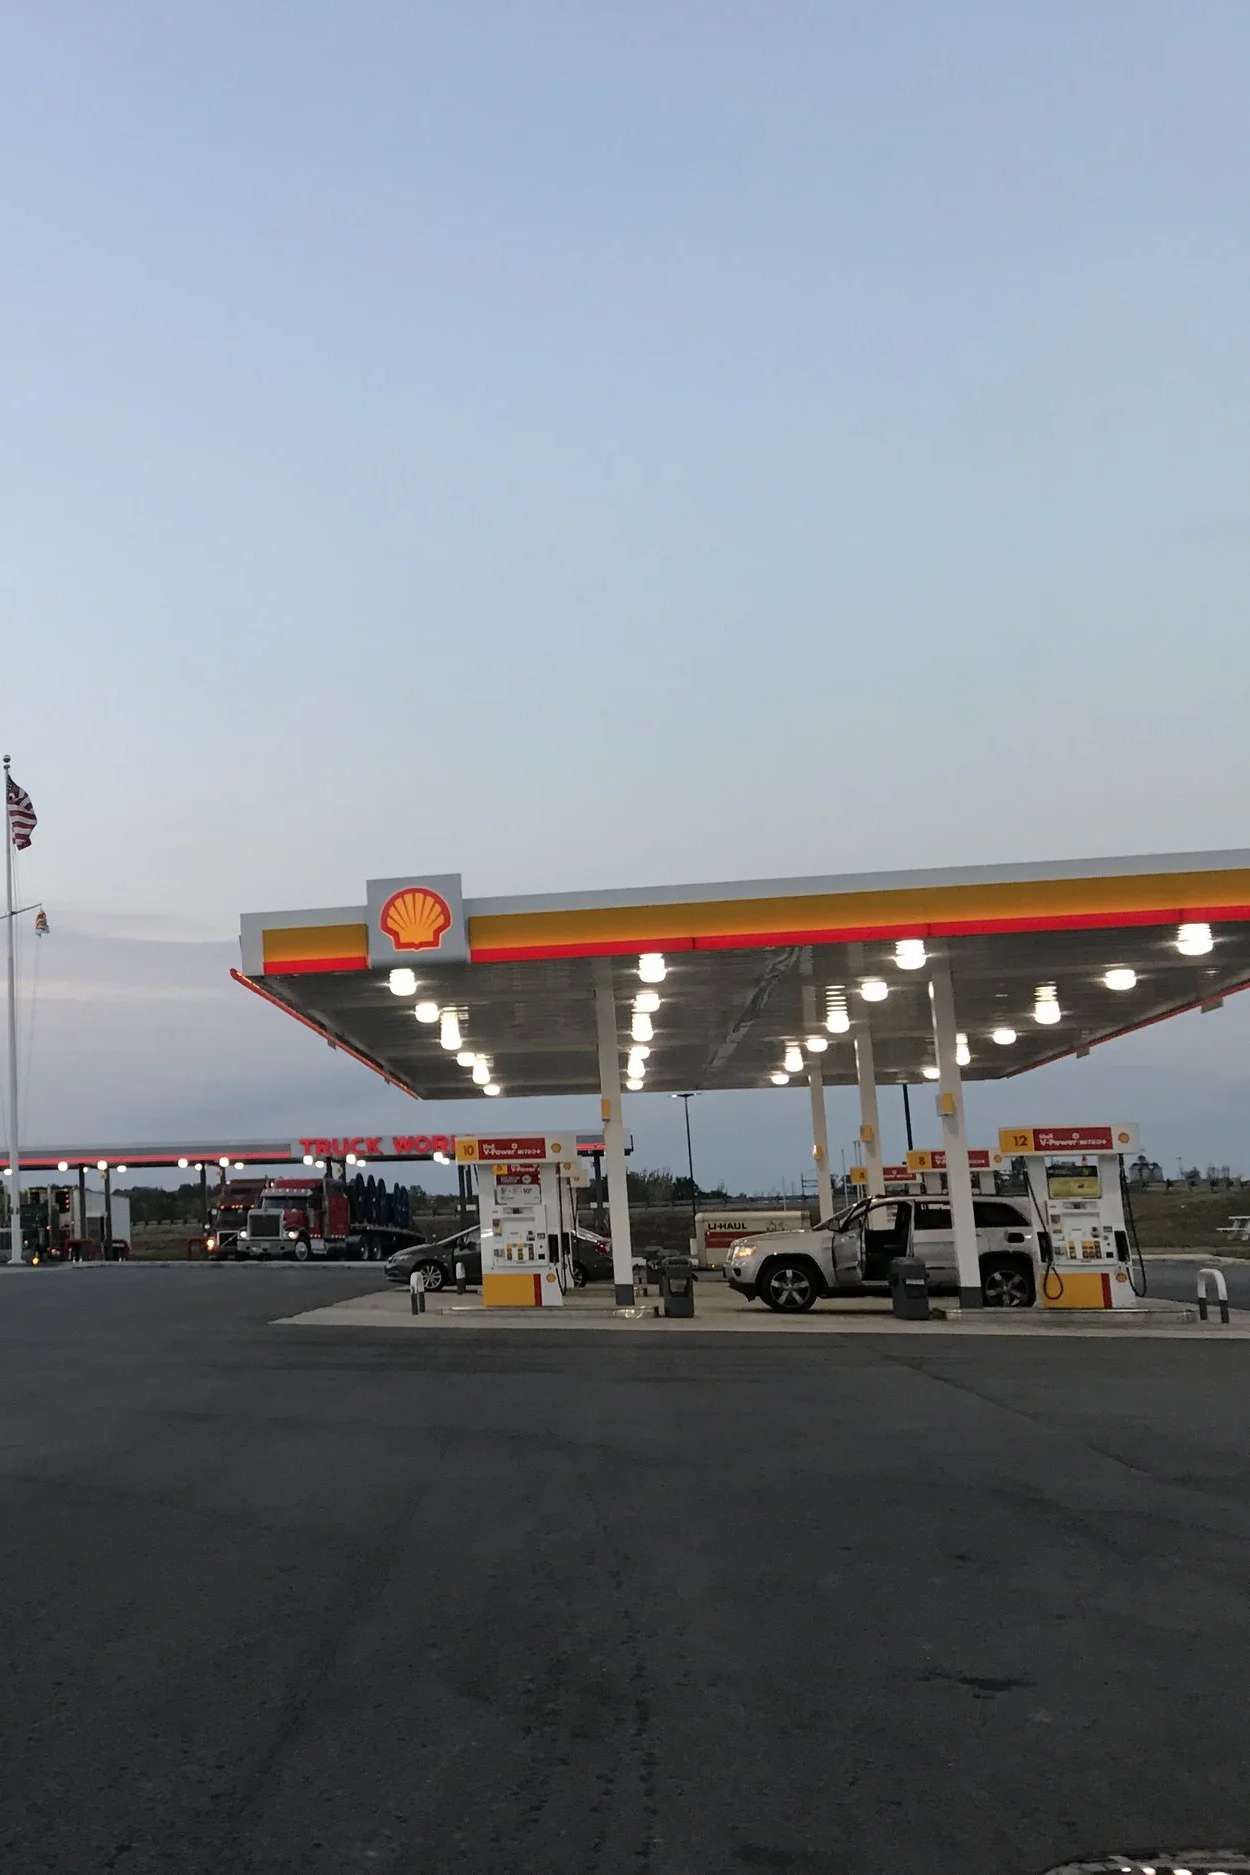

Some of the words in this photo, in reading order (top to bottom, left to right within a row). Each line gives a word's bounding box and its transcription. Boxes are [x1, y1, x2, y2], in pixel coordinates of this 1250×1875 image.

[298, 1136, 383, 1156] TRUCK
[1013, 1135, 1029, 1147] 12
[1039, 1138, 1077, 1146] V-Power
[463, 1144, 475, 1157] 10
[483, 1147, 516, 1156] V-Power
[918, 1156, 926, 1166] 8
[707, 1222, 748, 1230] U-HAUL
